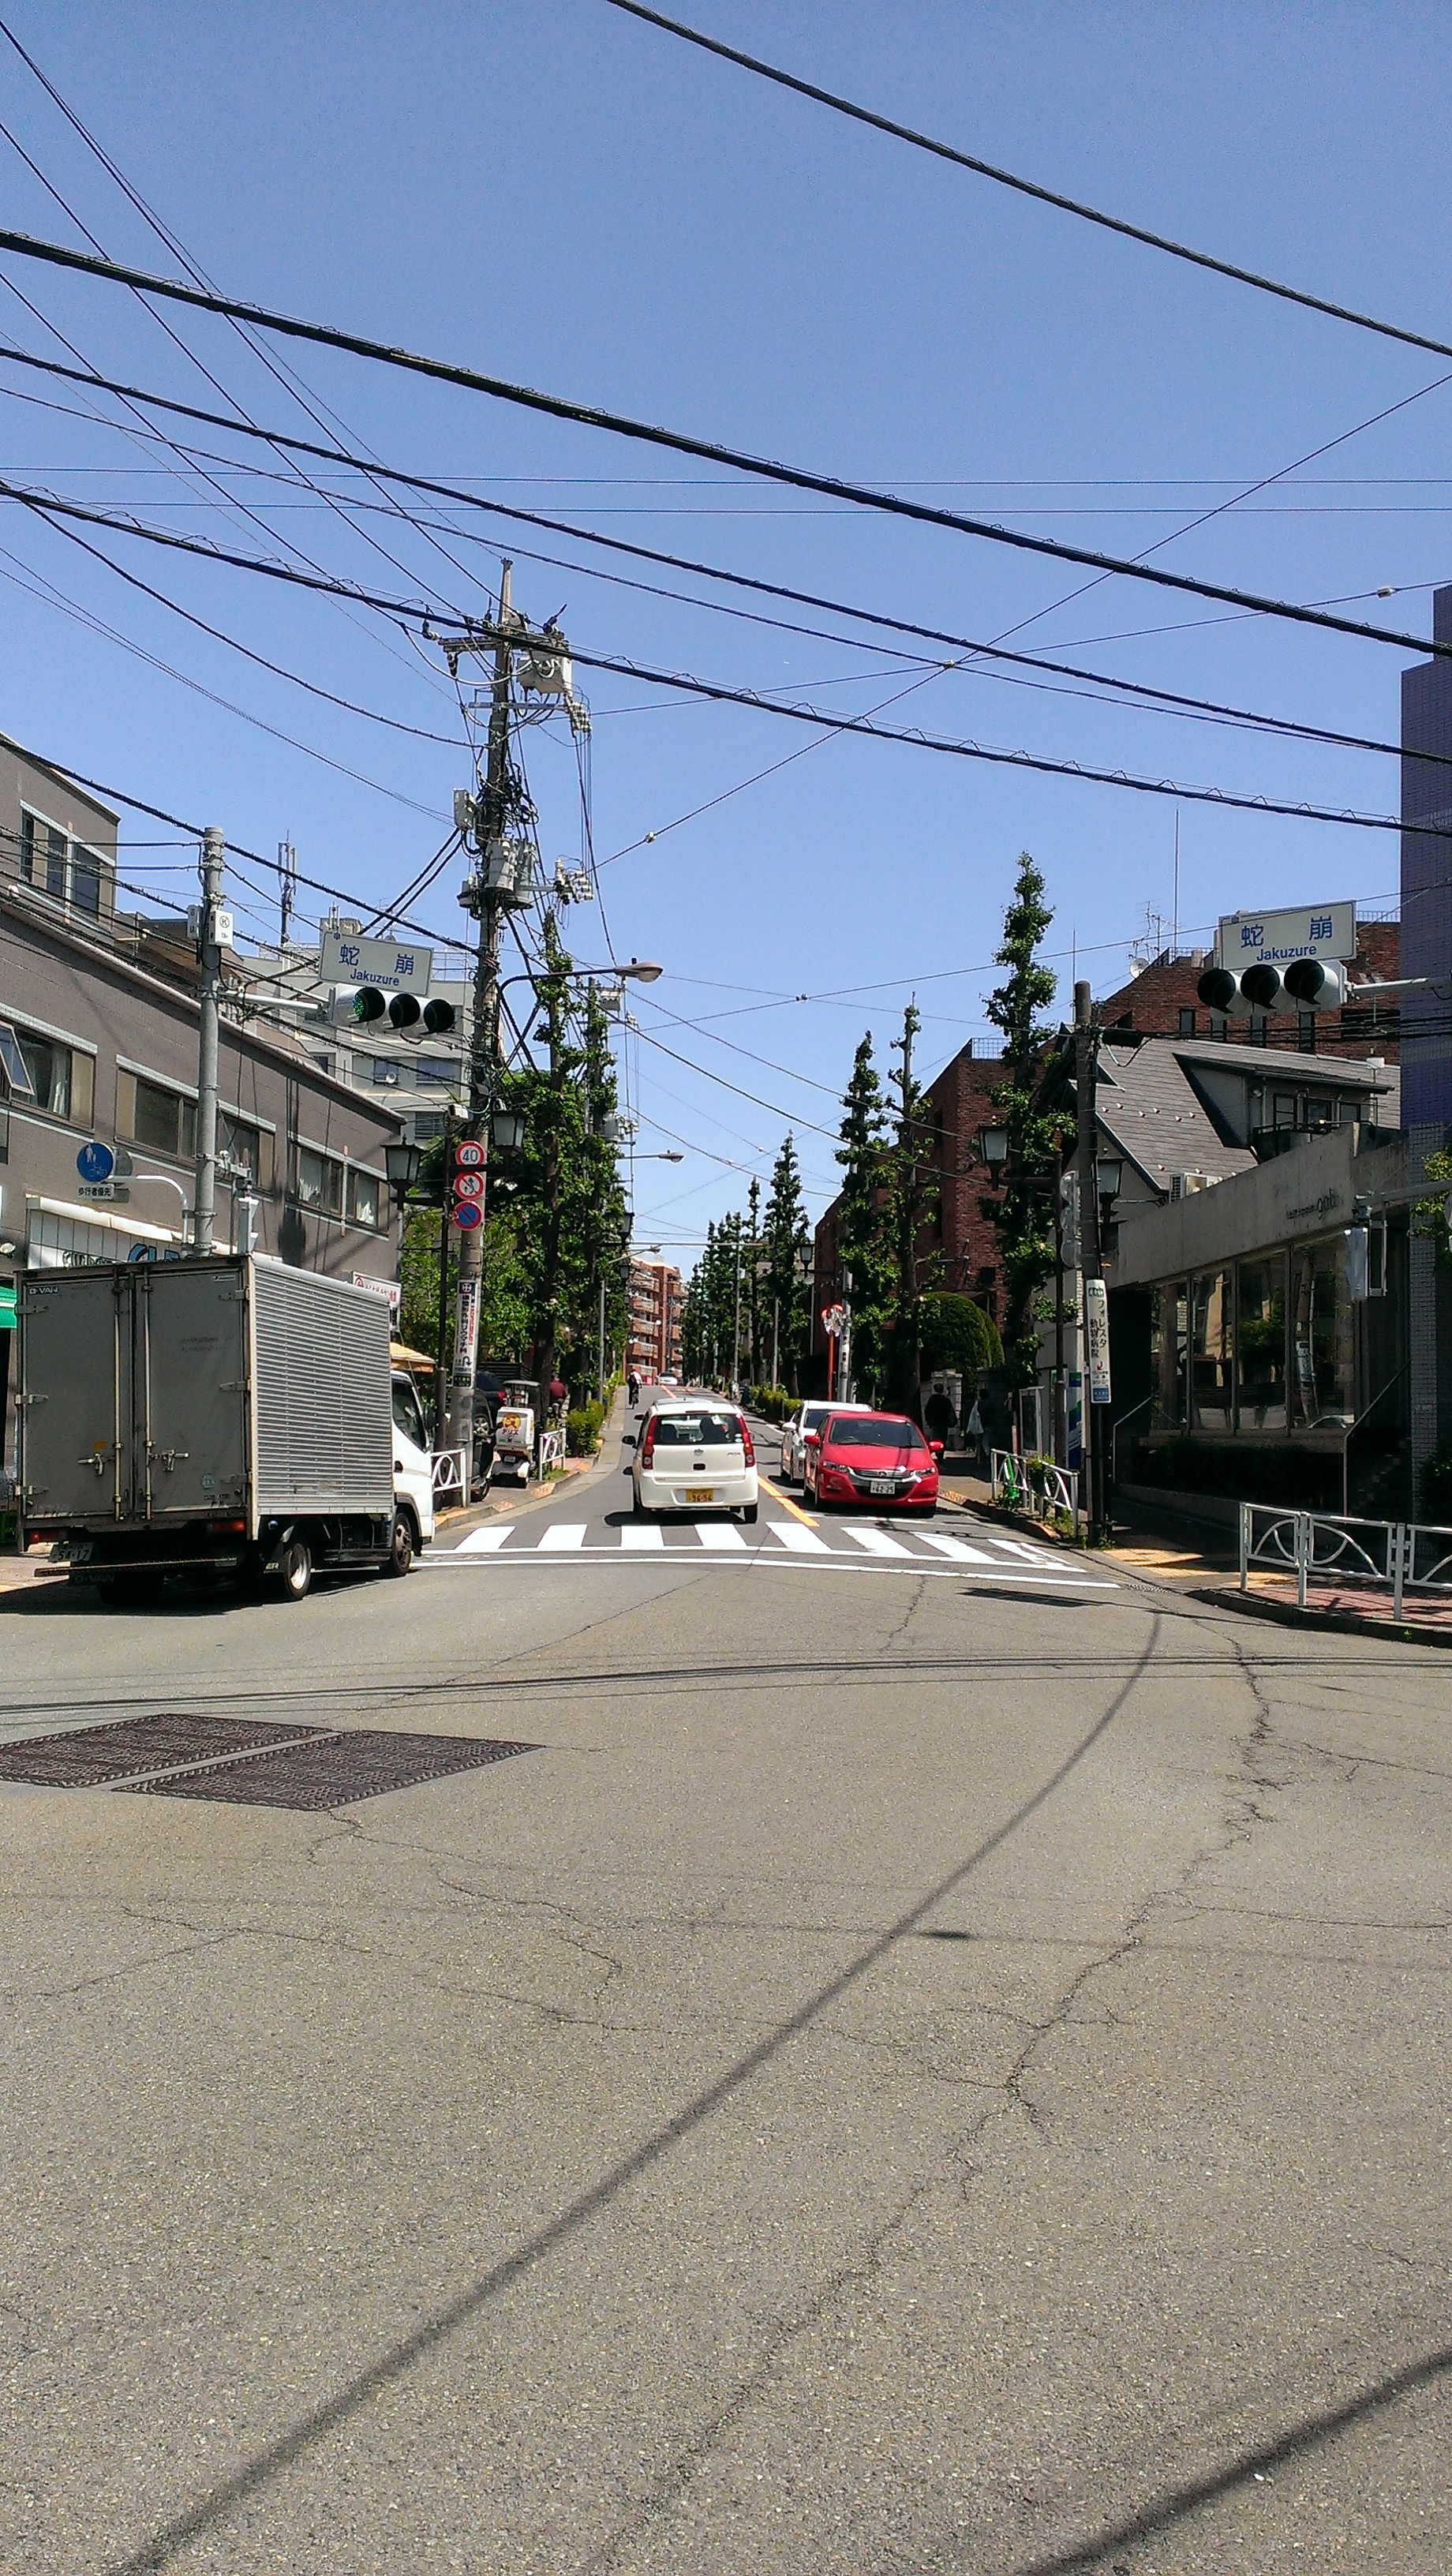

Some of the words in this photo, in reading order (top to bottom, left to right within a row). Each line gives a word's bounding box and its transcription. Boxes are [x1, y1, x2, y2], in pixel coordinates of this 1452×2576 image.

[1256, 945, 1317, 962] Jakuzure
[350, 968, 400, 987] Jakuzure
[462, 1149, 478, 1163] 40
[1097, 1300, 1107, 1349] フォレスタ
[1090, 1318, 1099, 1358] 動物病院
